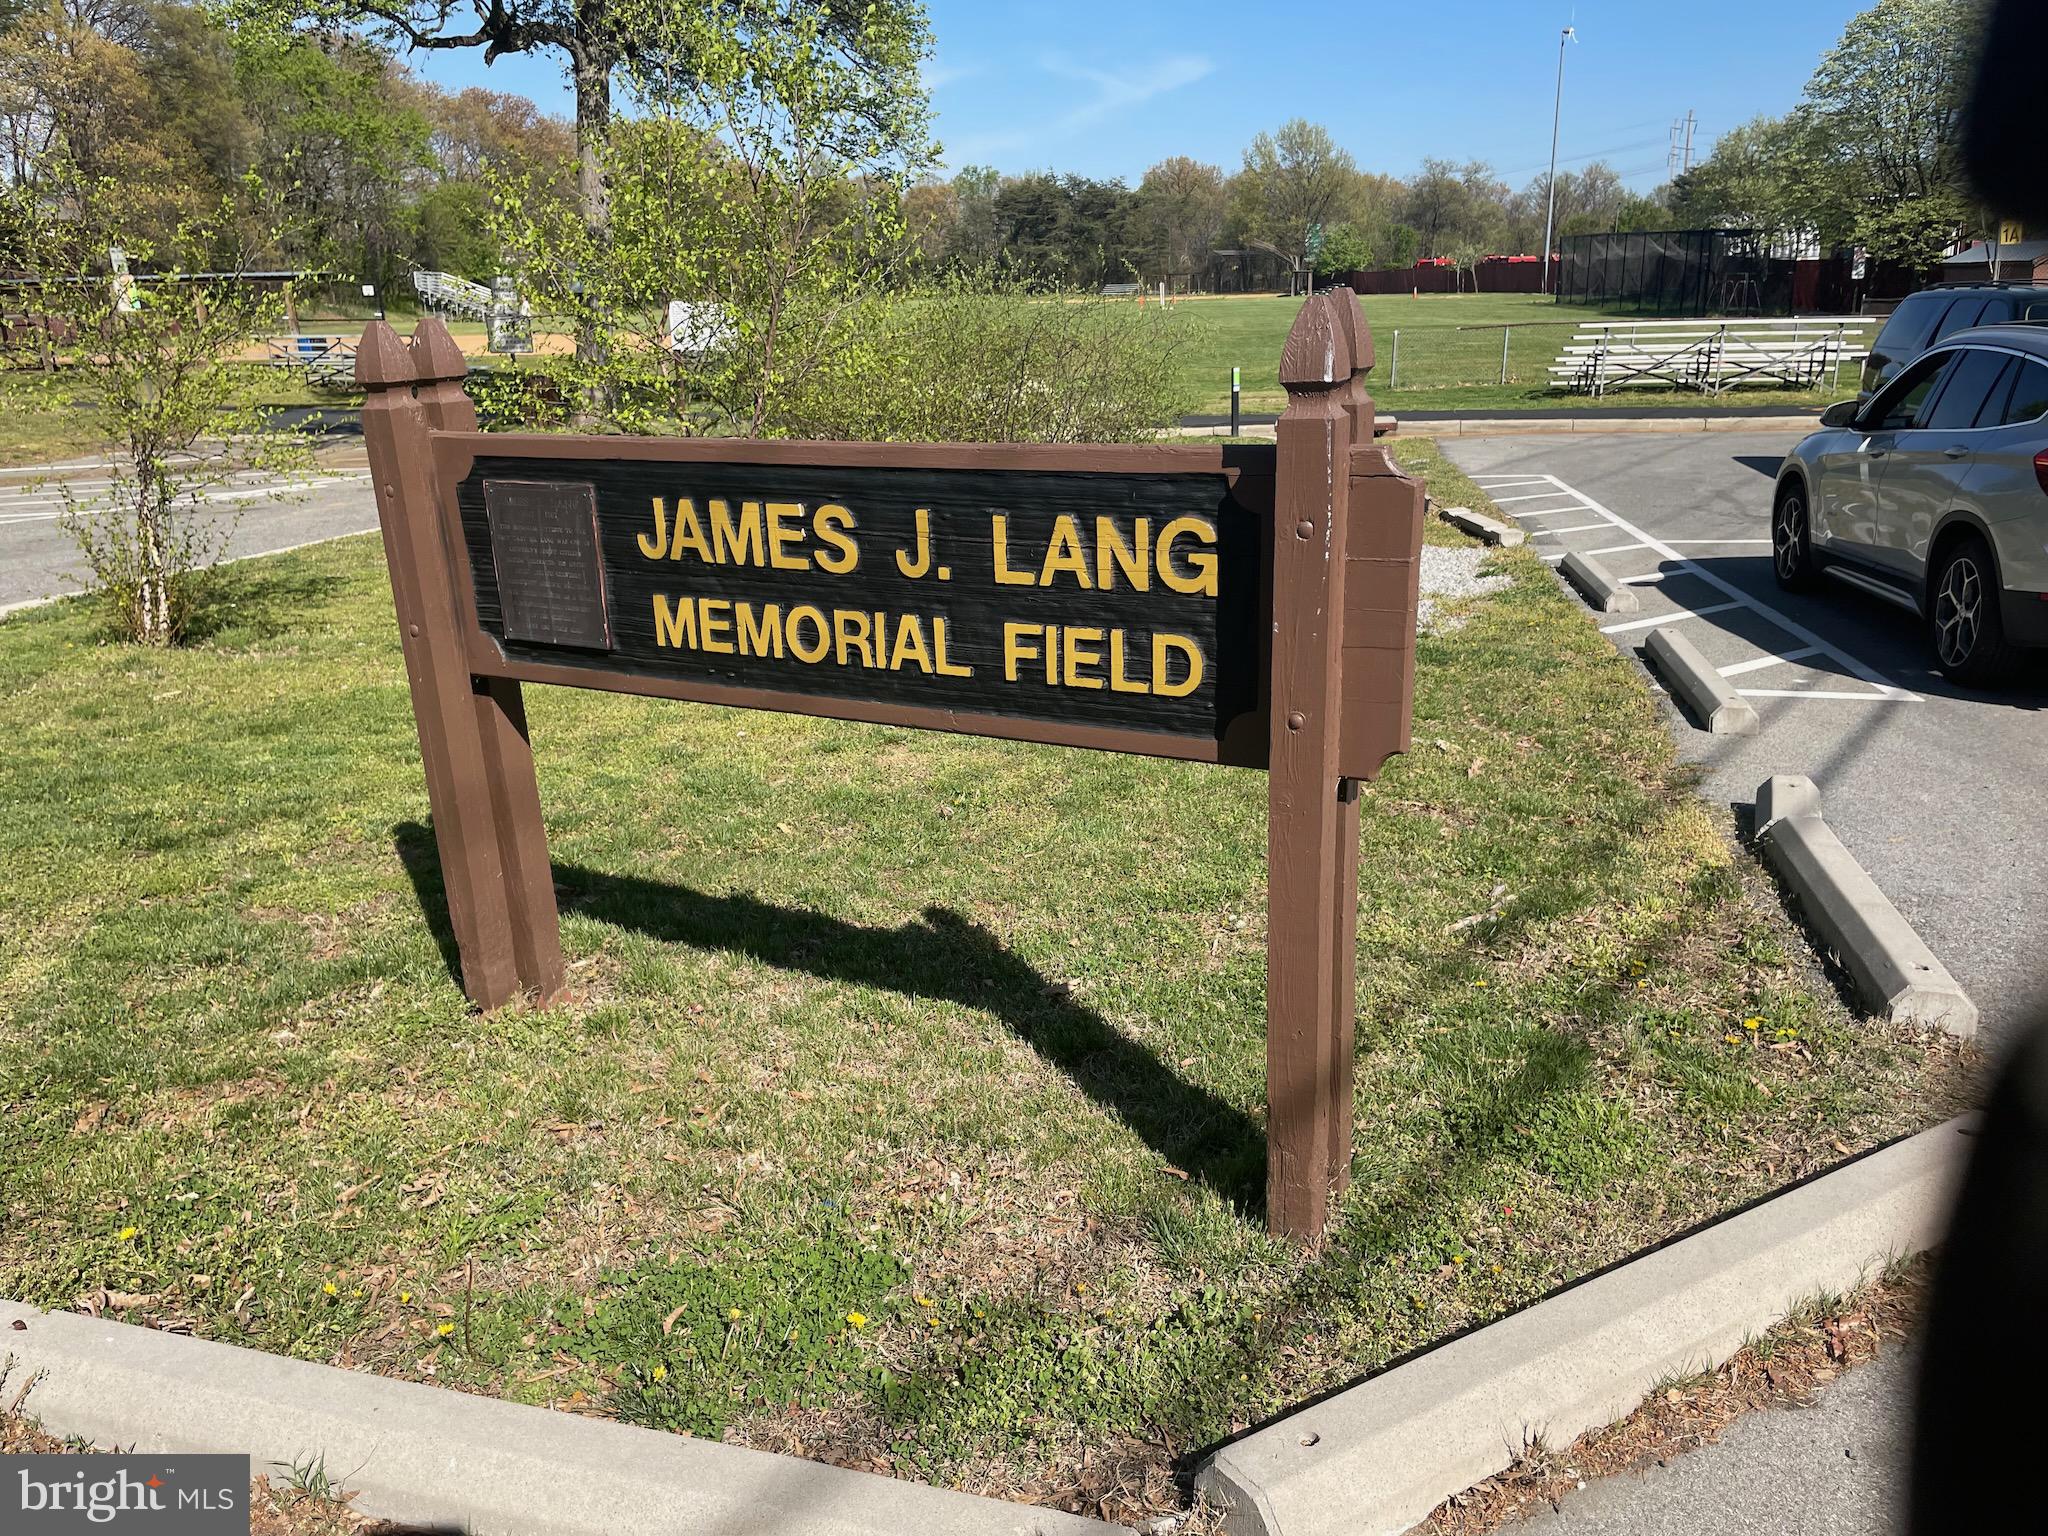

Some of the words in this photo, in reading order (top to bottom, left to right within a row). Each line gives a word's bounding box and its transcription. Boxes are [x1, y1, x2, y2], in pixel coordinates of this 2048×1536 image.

[636, 497, 860, 575] JAMES
[895, 508, 951, 580] J.
[991, 514, 1219, 597] LANG
[652, 593, 973, 678] MEMORIAL
[1003, 621, 1203, 698] FIELD
